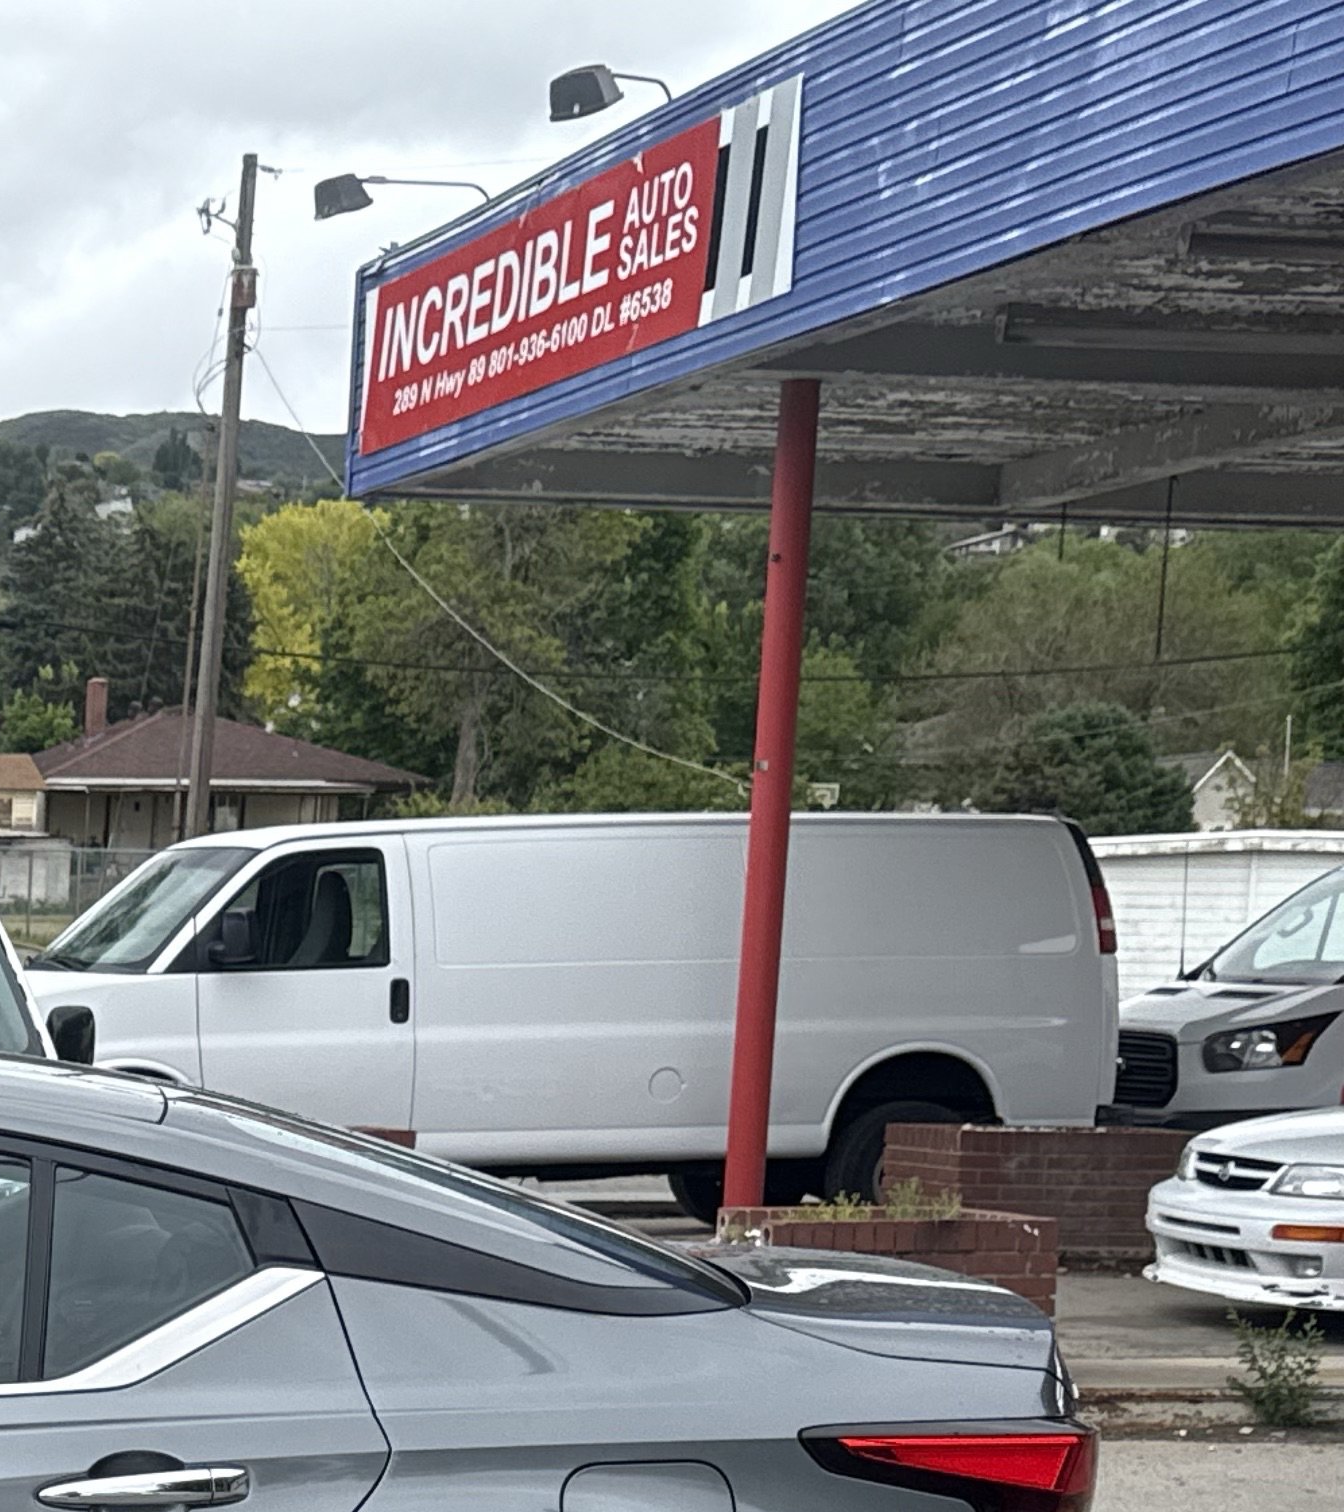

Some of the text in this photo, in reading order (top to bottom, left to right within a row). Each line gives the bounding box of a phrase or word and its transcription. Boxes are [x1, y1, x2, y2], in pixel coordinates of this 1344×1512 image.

[616, 205, 700, 281] SALES
[623, 161, 694, 235] AUTO
[377, 199, 615, 383] INCREDIBLE
[392, 277, 674, 416] 289 N Hwy 89 801-936-6100 DL #6538
